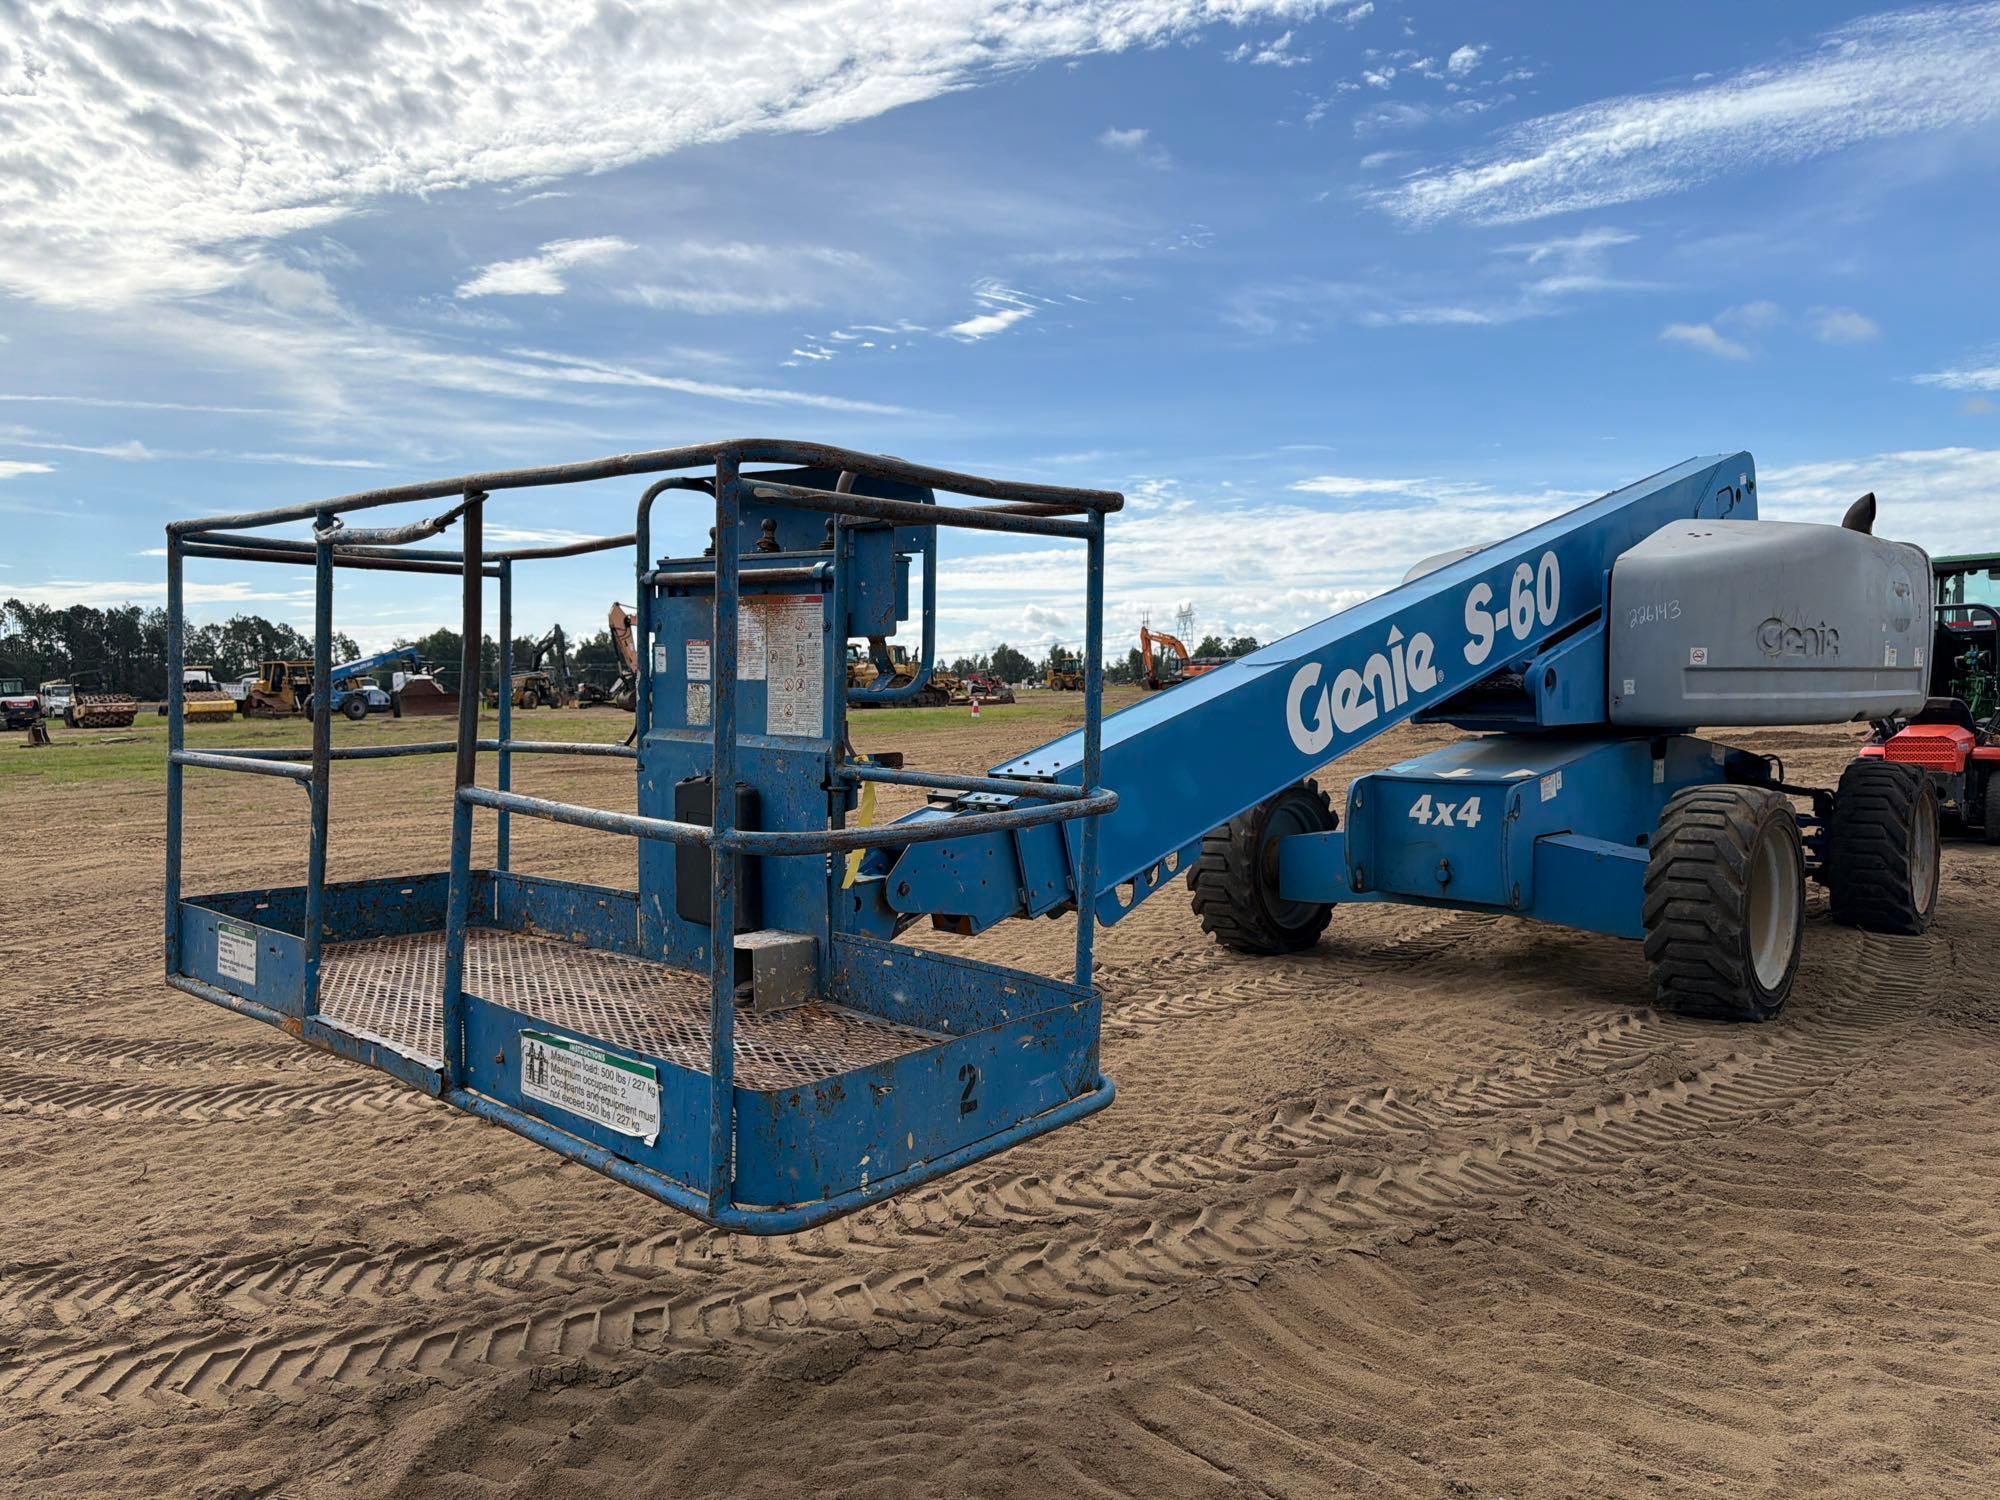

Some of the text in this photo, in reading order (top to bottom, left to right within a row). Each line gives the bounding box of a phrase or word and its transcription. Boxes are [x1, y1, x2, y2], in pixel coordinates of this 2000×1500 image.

[1463, 550, 1561, 666] S-60
[1629, 599, 1682, 629] 226143
[1756, 620, 1840, 658] Genie
[1286, 624, 1437, 755] Genie
[1409, 794, 1481, 828] 4x4
[551, 1050, 582, 1069] Maximum
[582, 1058, 599, 1076] load:
[601, 1067, 614, 1081] 500
[615, 1070, 627, 1085] lbs
[632, 1077, 646, 1091] 227
[551, 1063, 582, 1082] Maximum
[583, 1076, 620, 1097] occupants:
[550, 1075, 656, 1124] Occupants and equipment must
[550, 1089, 561, 1100] not
[561, 1094, 585, 1110] exceed
[586, 1101, 600, 1115] 500
[601, 1104, 611, 1120] lbs
[616, 1112, 631, 1127] 227
[958, 1063, 978, 1118] 2
